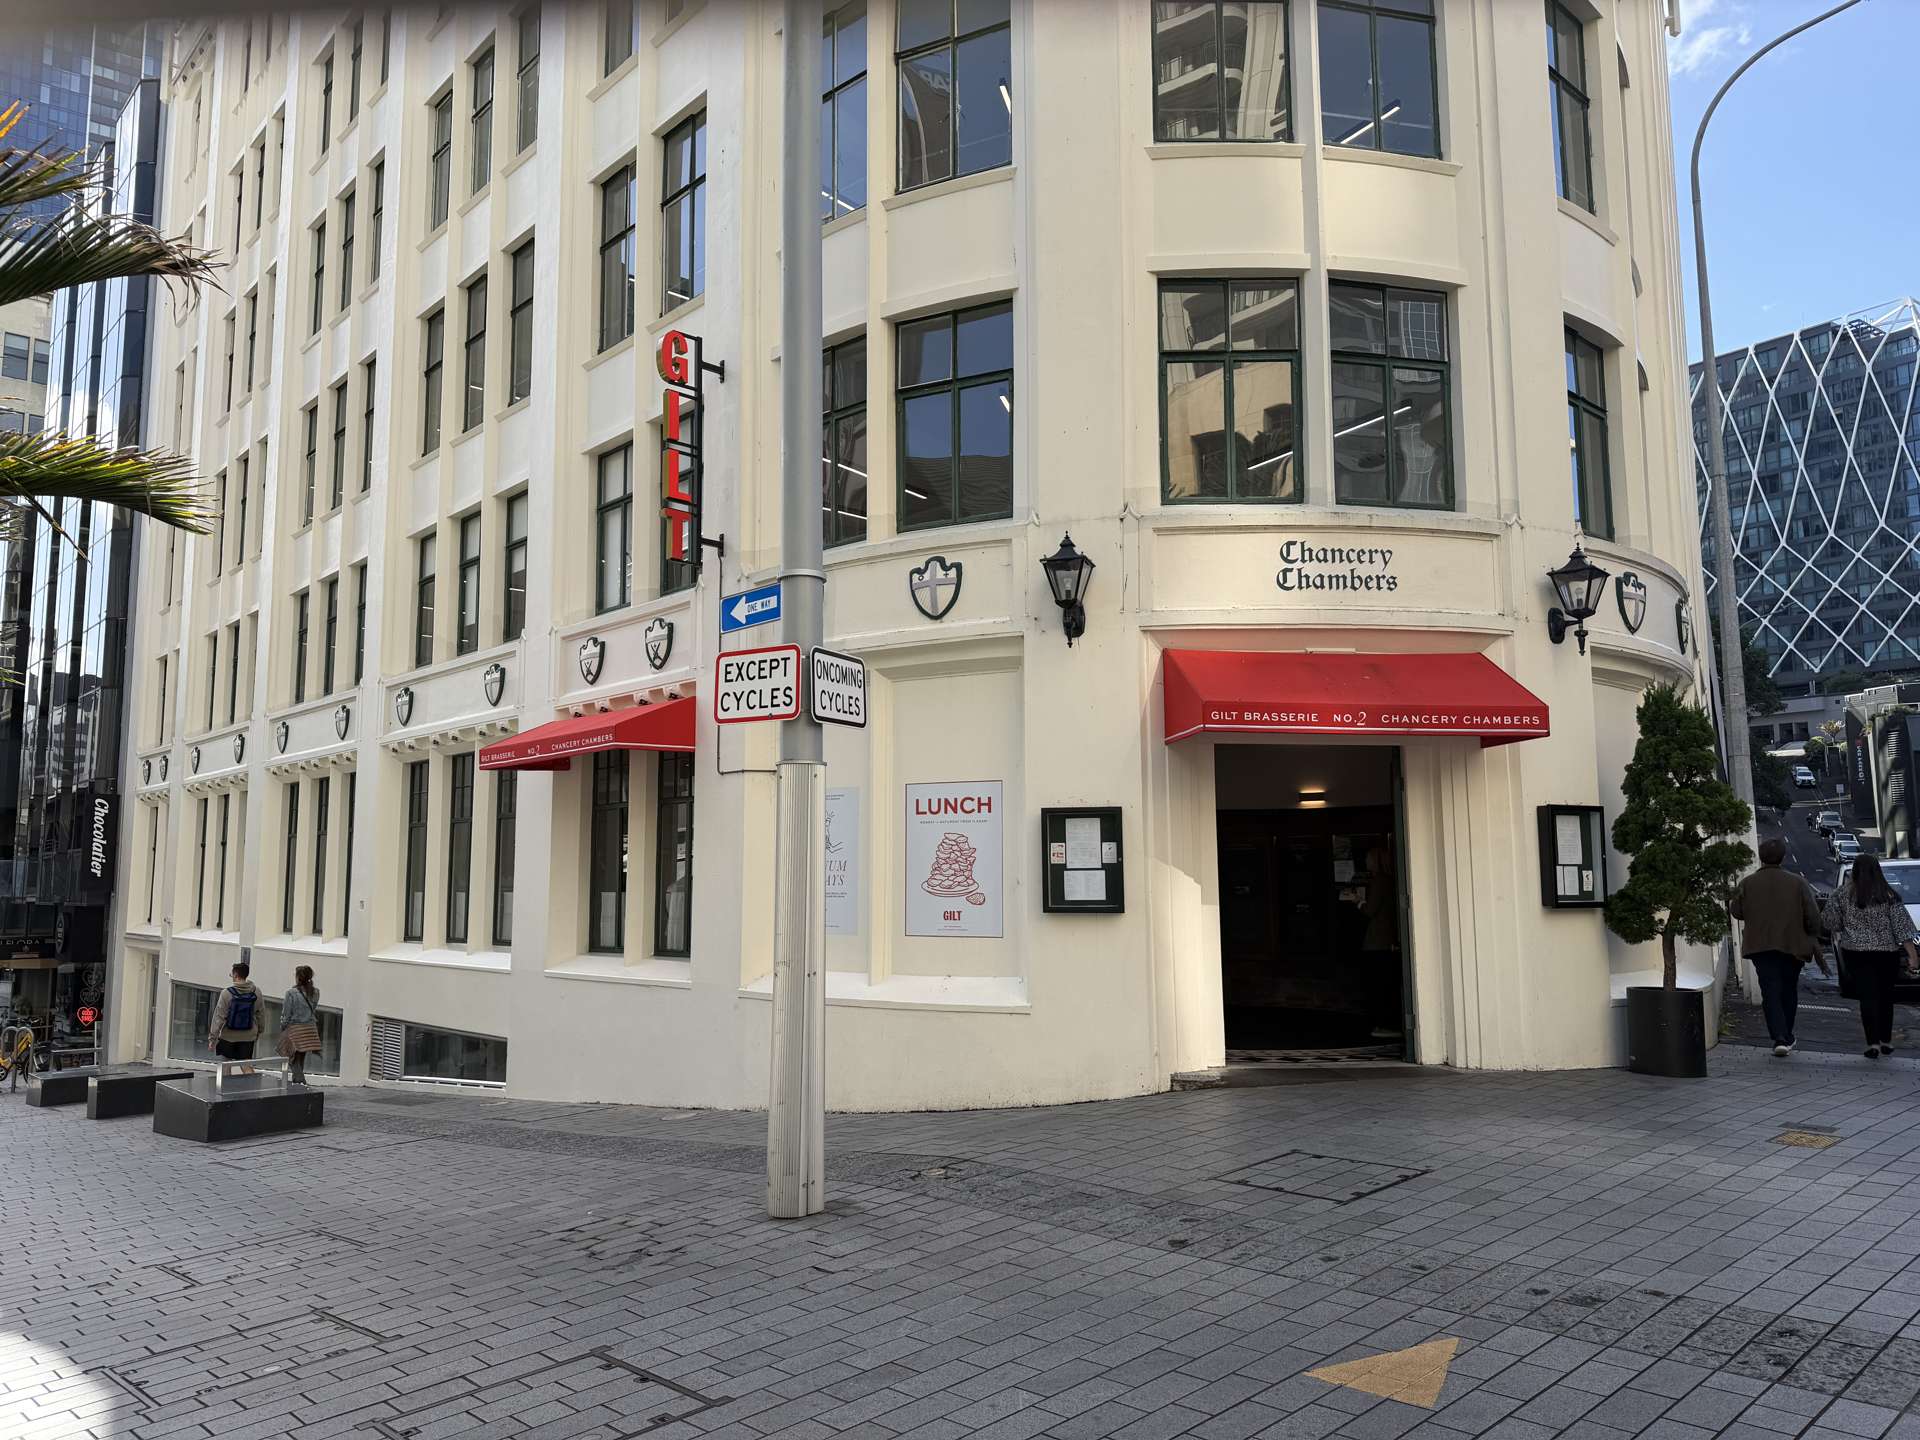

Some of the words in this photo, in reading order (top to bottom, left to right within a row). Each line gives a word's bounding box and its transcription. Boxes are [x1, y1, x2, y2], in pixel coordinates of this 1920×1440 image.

[656, 329, 693, 562] GILT
[1279, 540, 1393, 571] Chancery
[1276, 566, 1398, 592] Chambers
[747, 602, 758, 614] ONE
[760, 599, 771, 611] WAY
[724, 656, 791, 683] EXCEPT
[816, 658, 862, 689] ONCOMING
[720, 686, 793, 712] CYCLES
[820, 689, 861, 717] CYCLES
[1211, 711, 1238, 721] GILT
[1244, 712, 1319, 722] BRASSERIE
[1381, 714, 1458, 725] CHANCERY
[1463, 715, 1540, 726] CHAMBERS
[491, 750, 516, 761] BRASSERIE
[551, 739, 580, 752] CHANCERY
[581, 733, 613, 746] CHAMBERS
[915, 796, 992, 816] LUNCH
[90, 798, 110, 877] Chocolatier
[943, 910, 963, 921] GILT
